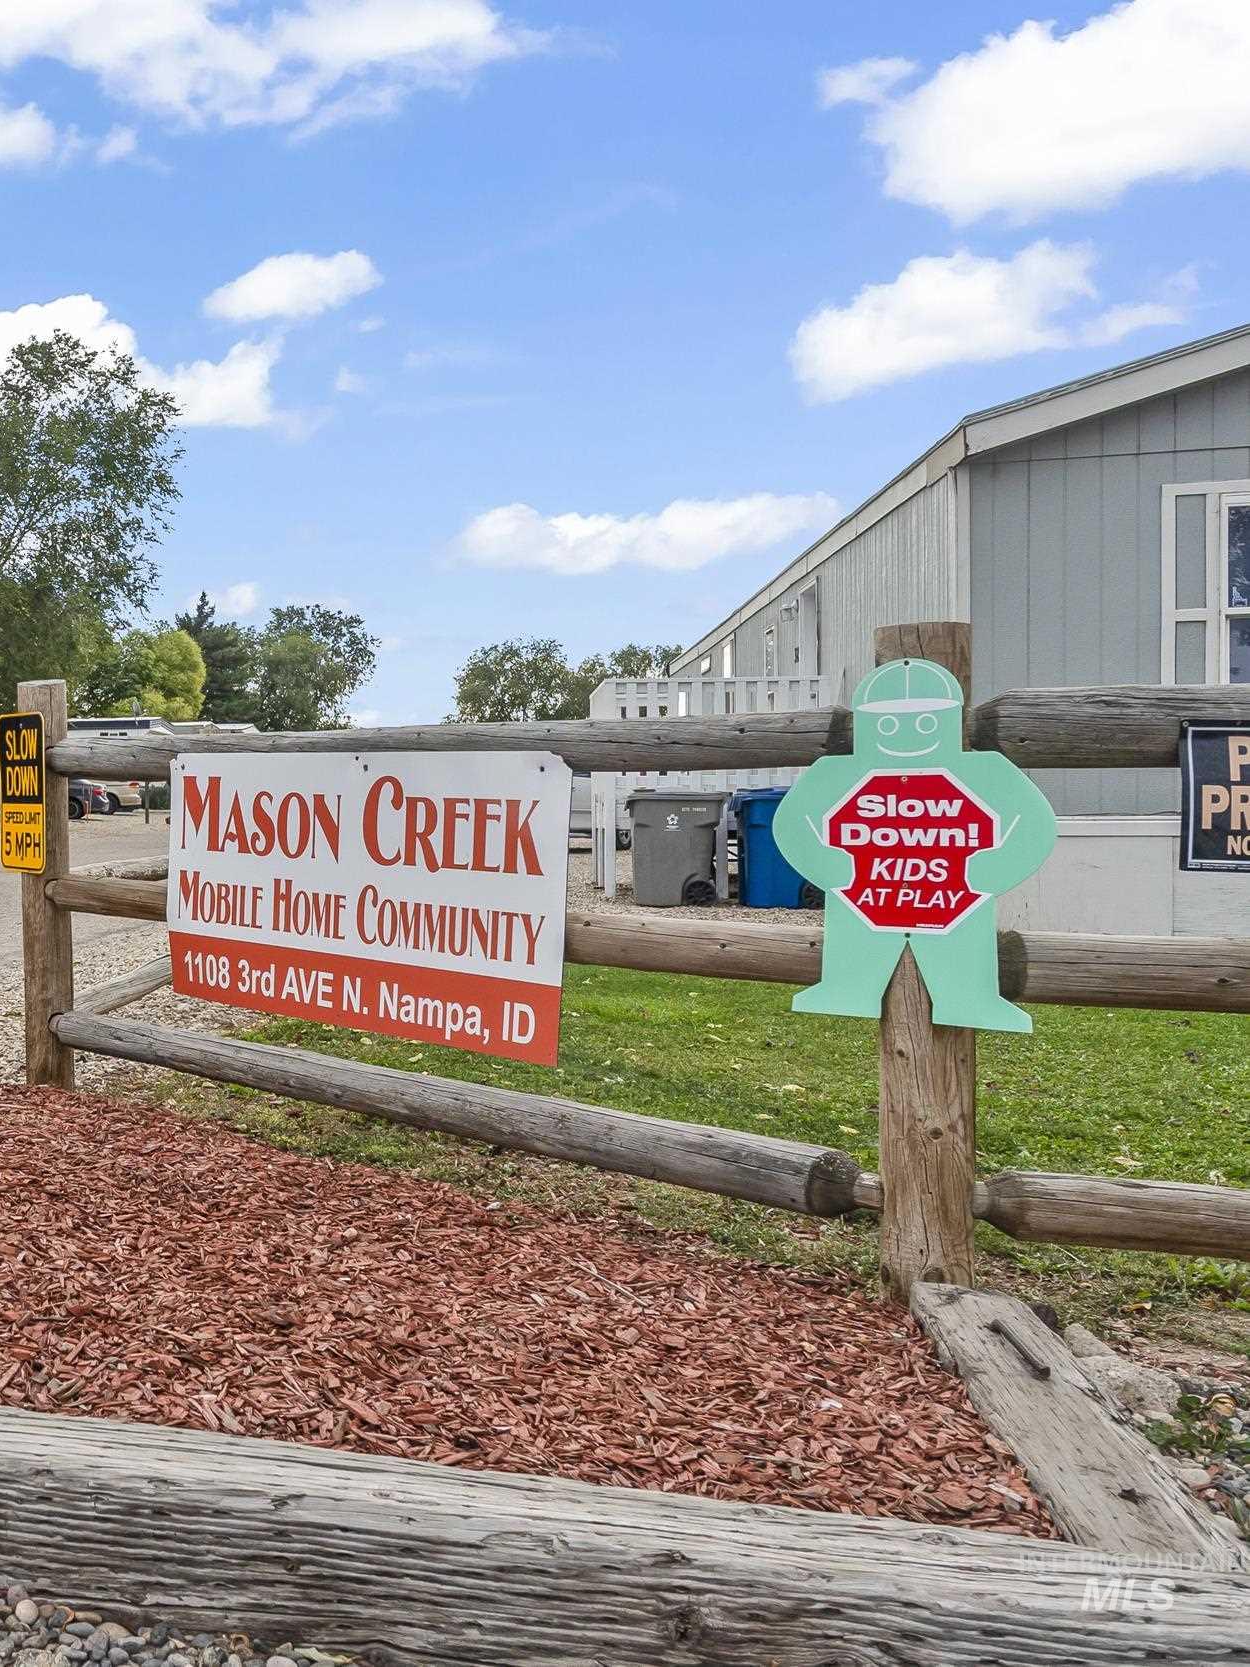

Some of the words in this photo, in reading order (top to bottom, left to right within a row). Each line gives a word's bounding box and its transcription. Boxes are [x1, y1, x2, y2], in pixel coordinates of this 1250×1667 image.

[5, 728, 38, 761] SLOW
[6, 765, 39, 797] DOWN
[4, 811, 23, 824] SPEED
[24, 812, 41, 825] LIMIT
[856, 794, 963, 818] Slow
[181, 775, 342, 864] MASON
[362, 775, 545, 874] CREEK
[840, 823, 980, 847] Down!
[4, 831, 12, 856] 5
[15, 832, 41, 858] MPH
[870, 858, 949, 883] KIDS
[856, 888, 893, 906] AT
[896, 889, 966, 909] PLAY
[178, 869, 264, 930] MOBILE
[272, 878, 347, 940] HOME
[356, 884, 545, 965] COMMUNITY
[183, 950, 231, 990] 1108
[237, 959, 276, 998] 3rd
[281, 966, 334, 1009] AVE
[342, 975, 368, 1016] N.
[379, 982, 489, 1045] Nampa,
[502, 1001, 536, 1045] ID
